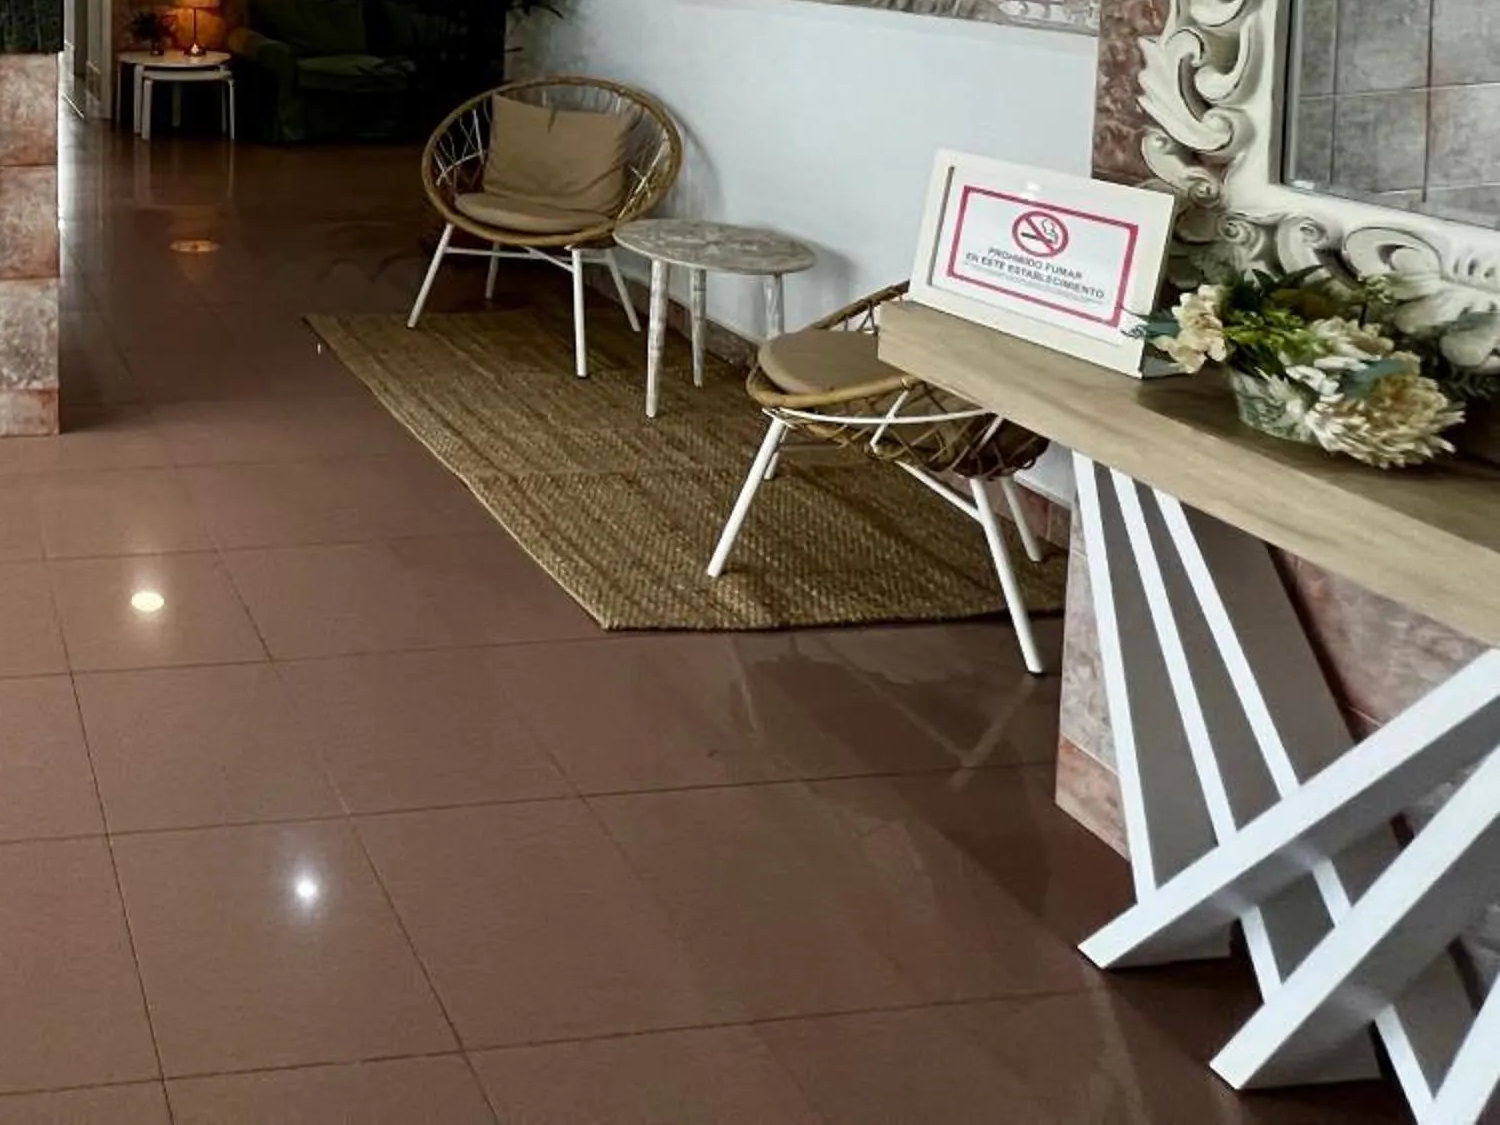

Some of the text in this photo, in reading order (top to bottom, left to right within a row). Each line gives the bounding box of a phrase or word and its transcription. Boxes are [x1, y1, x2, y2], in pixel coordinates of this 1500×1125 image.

[965, 252, 1105, 299] EN ESTE ESTABLECIMIENTO
[987, 247, 1083, 279] PROHIBIDO FUMAR
